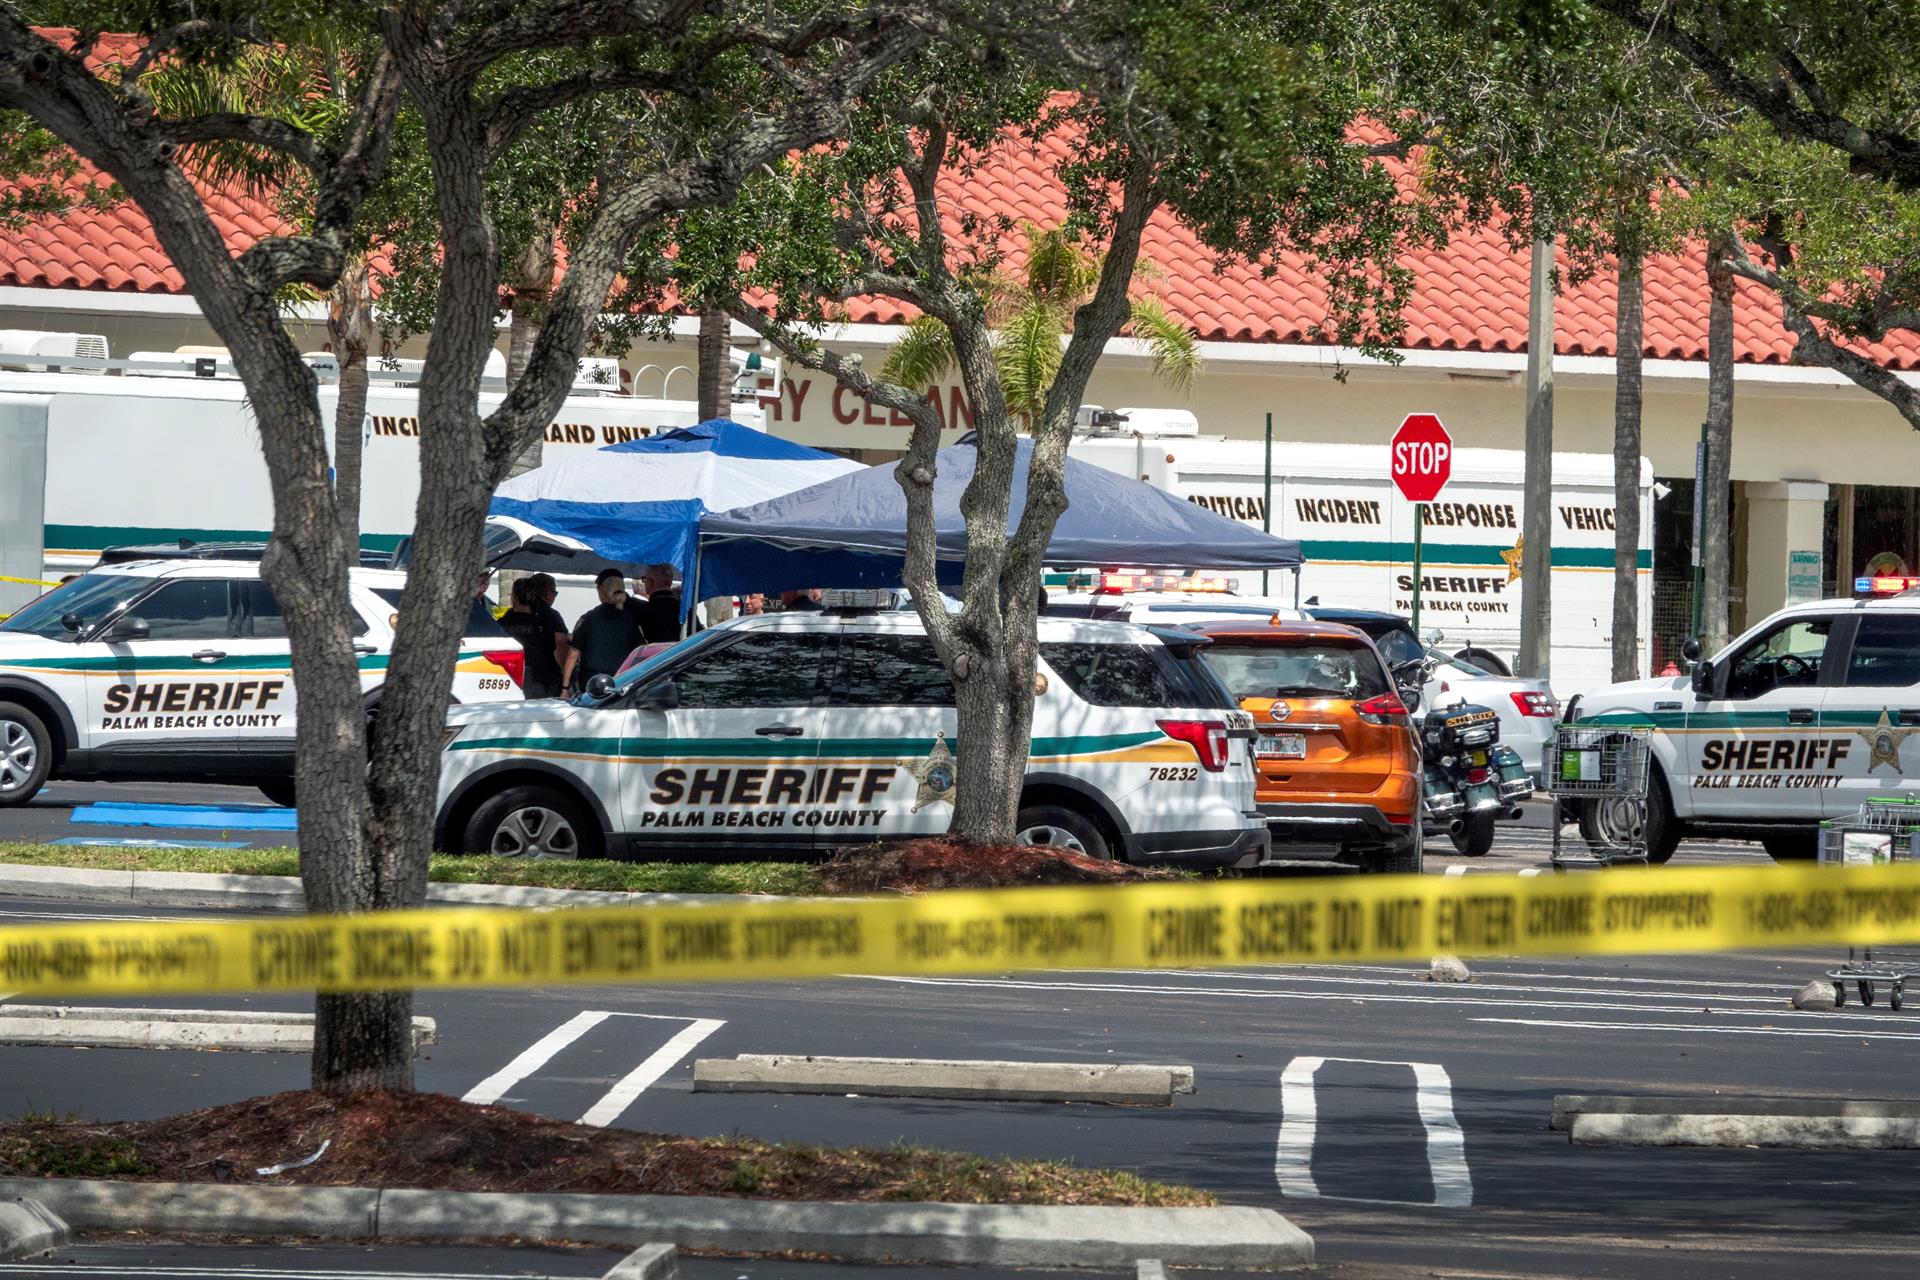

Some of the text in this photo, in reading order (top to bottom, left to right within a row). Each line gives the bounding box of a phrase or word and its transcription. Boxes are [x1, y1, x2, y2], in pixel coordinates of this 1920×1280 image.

[756, 378, 812, 422] RY
[372, 416, 420, 436] INCI
[602, 426, 651, 444] UNIT
[1395, 442, 1448, 475] STOP
[1295, 498, 1381, 524] INCIDENT
[1422, 502, 1517, 529] RESPONSE
[1559, 505, 1616, 531] VEHIC
[1397, 575, 1506, 594] SHERIFF
[1429, 600, 1463, 611] BEACH
[1468, 601, 1508, 613] COUNTY
[103, 681, 284, 714] SHERIFF
[478, 678, 511, 690] 85899
[102, 714, 281, 730] PALM BEACH COUNTY
[1701, 739, 1852, 771] SHERIFF
[649, 768, 896, 805] SHERIFF
[1149, 767, 1198, 782] 78232
[1693, 775, 1843, 788] PALM BEACH COUNTY
[641, 809, 887, 827] PALM BEACH COUNTY
[250, 927, 338, 984] CRIME
[351, 927, 434, 981] SCENE
[448, 926, 482, 981] DO
[500, 920, 551, 977] NOT
[561, 917, 647, 975] ENTER
[663, 919, 734, 962] CRIME
[1145, 904, 1227, 959] CRIME
[1237, 902, 1316, 957] SCENE
[1329, 899, 1363, 953] DO
[1375, 898, 1422, 948] NOT
[1436, 896, 1515, 948] ENTER
[1526, 896, 1595, 937] CRIME
[1603, 891, 1714, 931] STOPPERS
